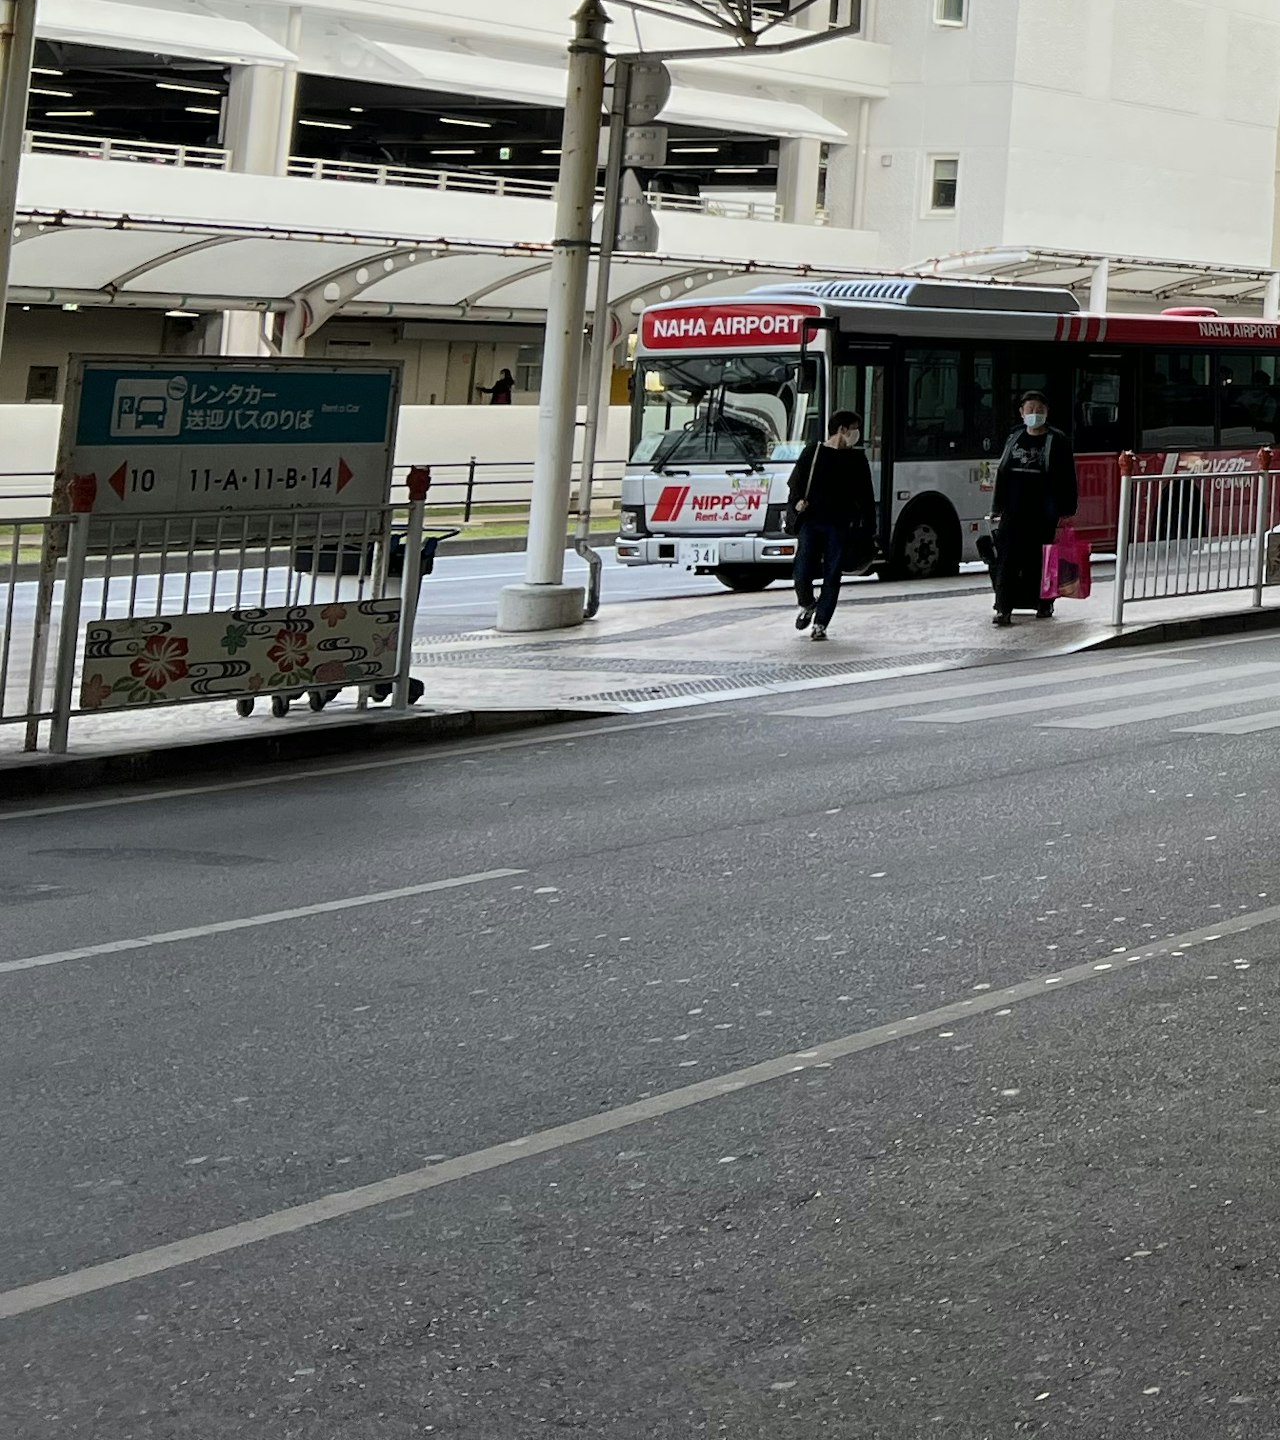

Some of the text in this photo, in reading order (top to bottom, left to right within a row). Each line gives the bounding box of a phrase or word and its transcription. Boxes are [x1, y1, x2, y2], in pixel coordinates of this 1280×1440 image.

[653, 315, 805, 338] NAHA AIRPORT
[1199, 322, 1279, 339] NAHA AIRPORT
[190, 384, 277, 405] レンタカー
[184, 409, 314, 431] 送迎バスのりば
[131, 468, 155, 492] 10
[692, 494, 761, 511] NIPPON
[694, 512, 753, 522] Rent-A-Car
